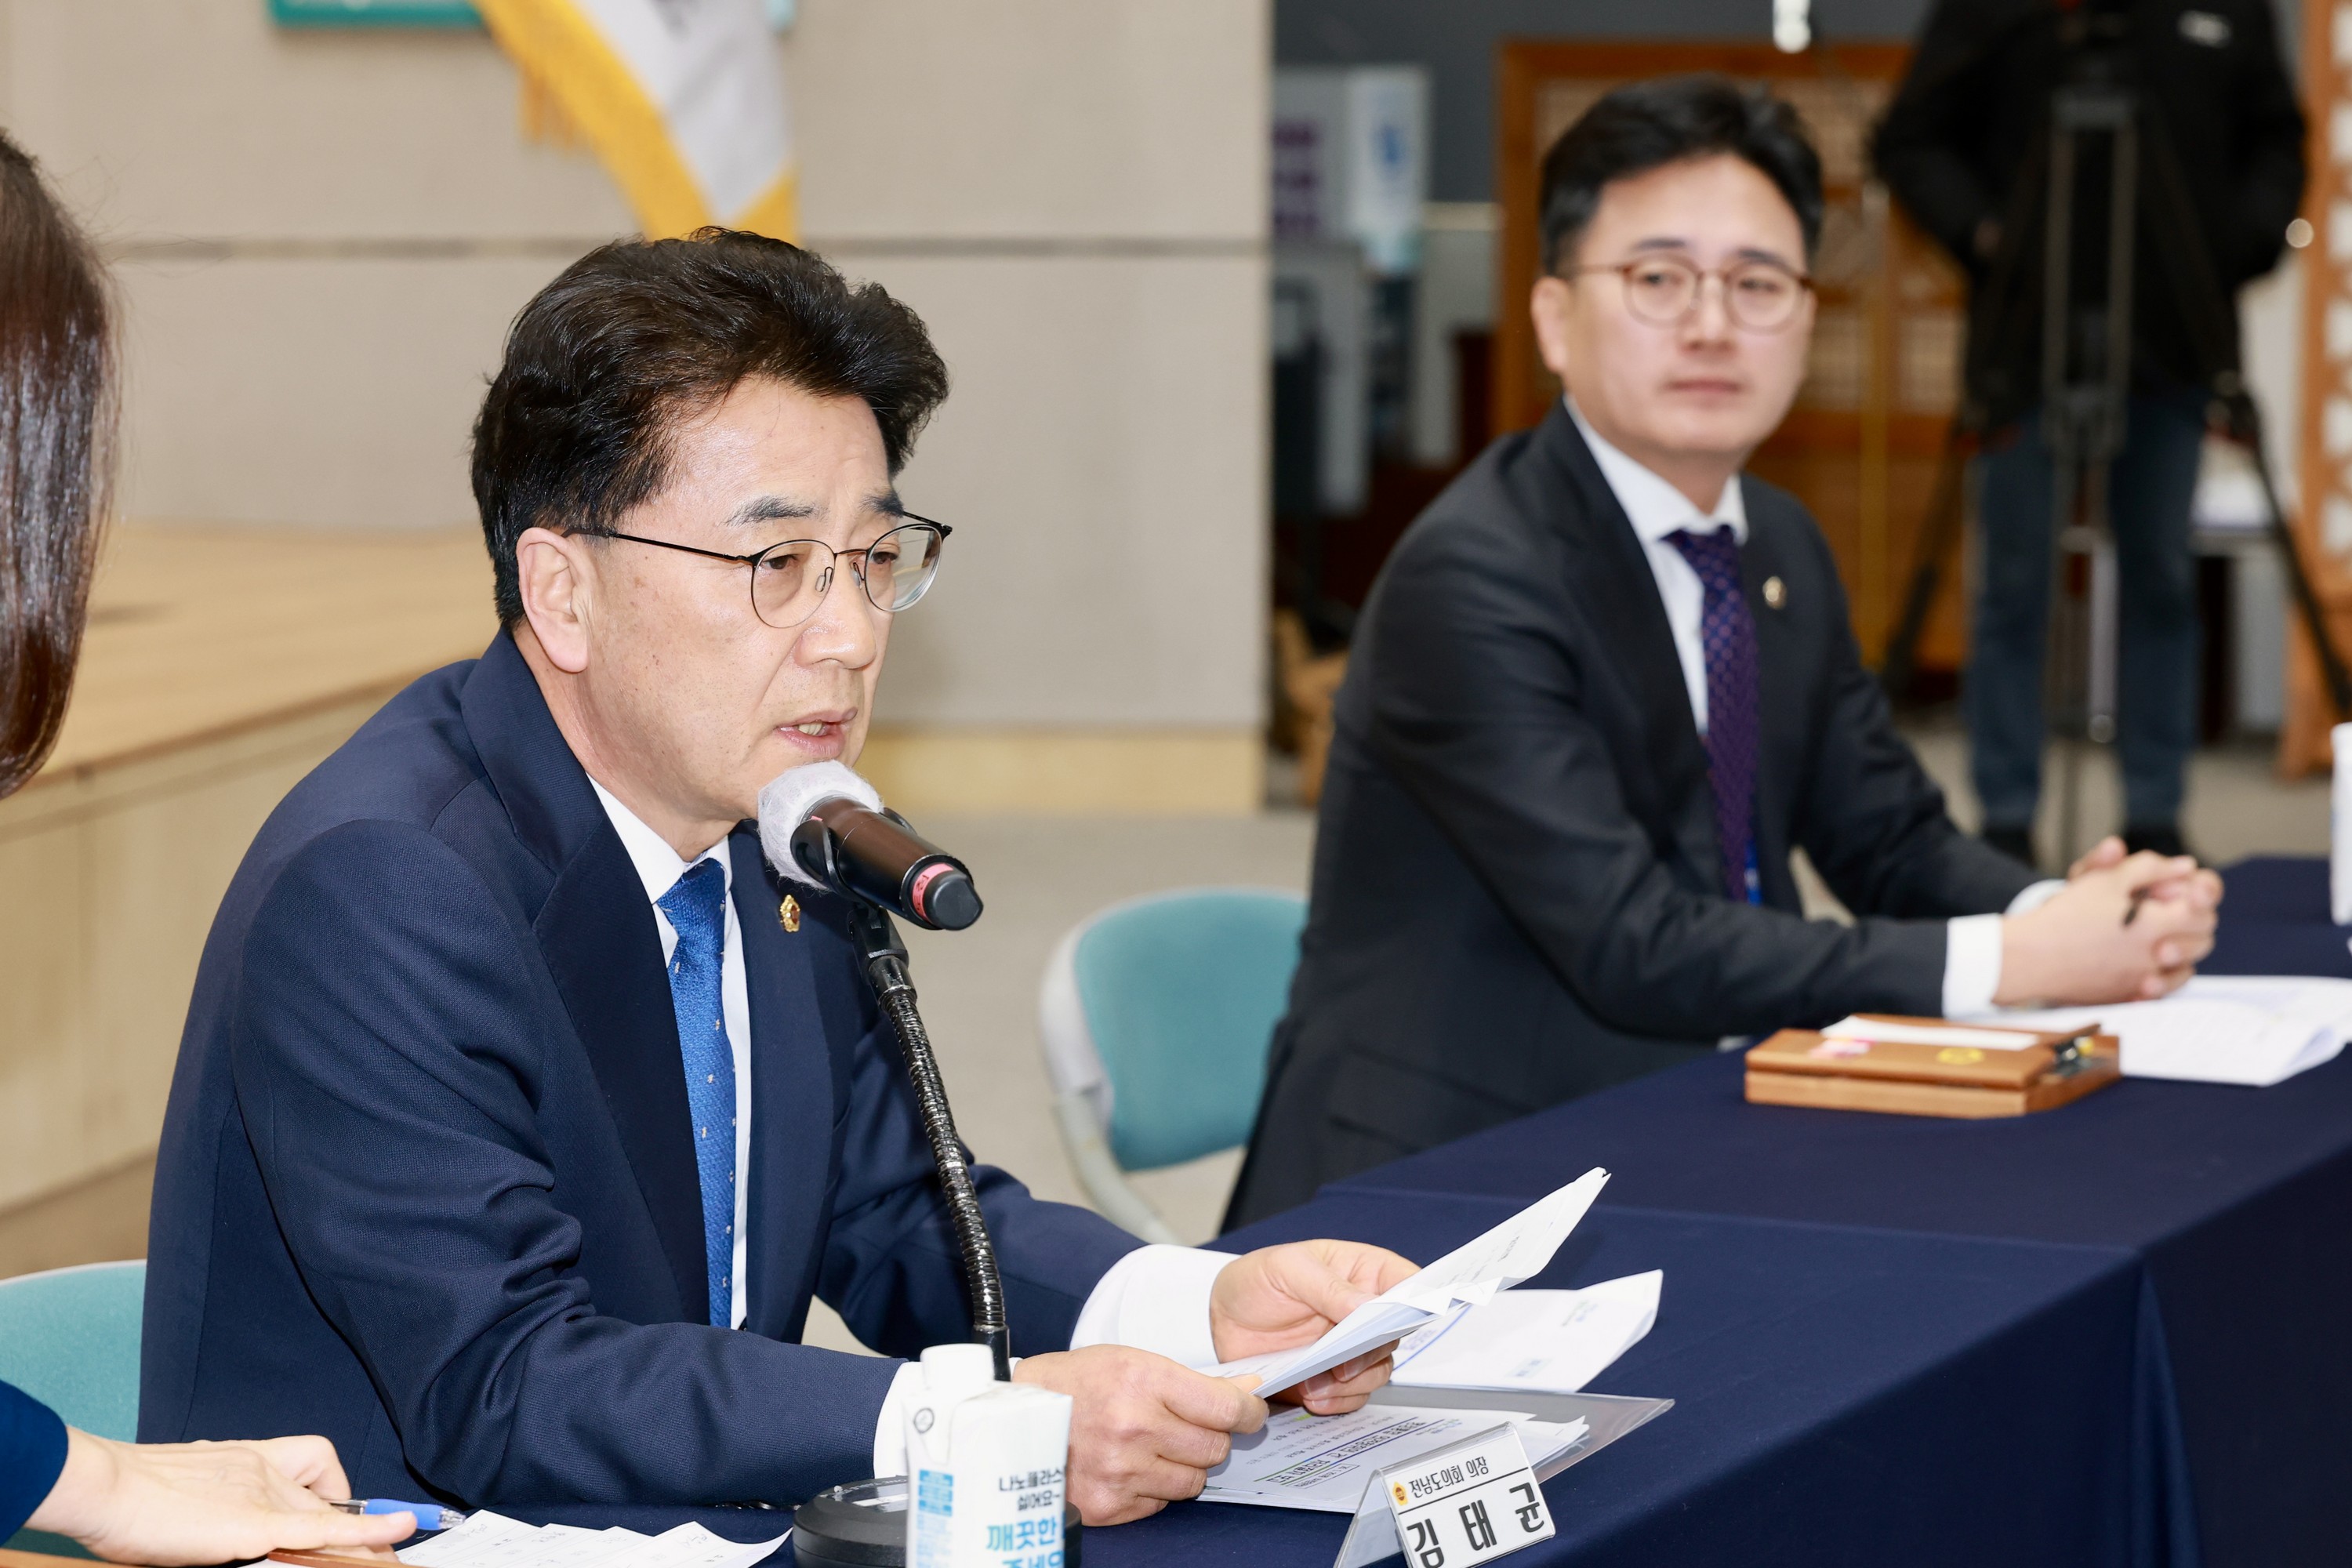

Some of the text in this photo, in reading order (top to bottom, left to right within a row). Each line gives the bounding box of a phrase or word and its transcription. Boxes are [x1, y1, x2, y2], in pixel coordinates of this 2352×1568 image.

[1408, 1456, 1489, 1498] 전남도의회 의장
[986, 1517, 1057, 1552] 깨끗한
